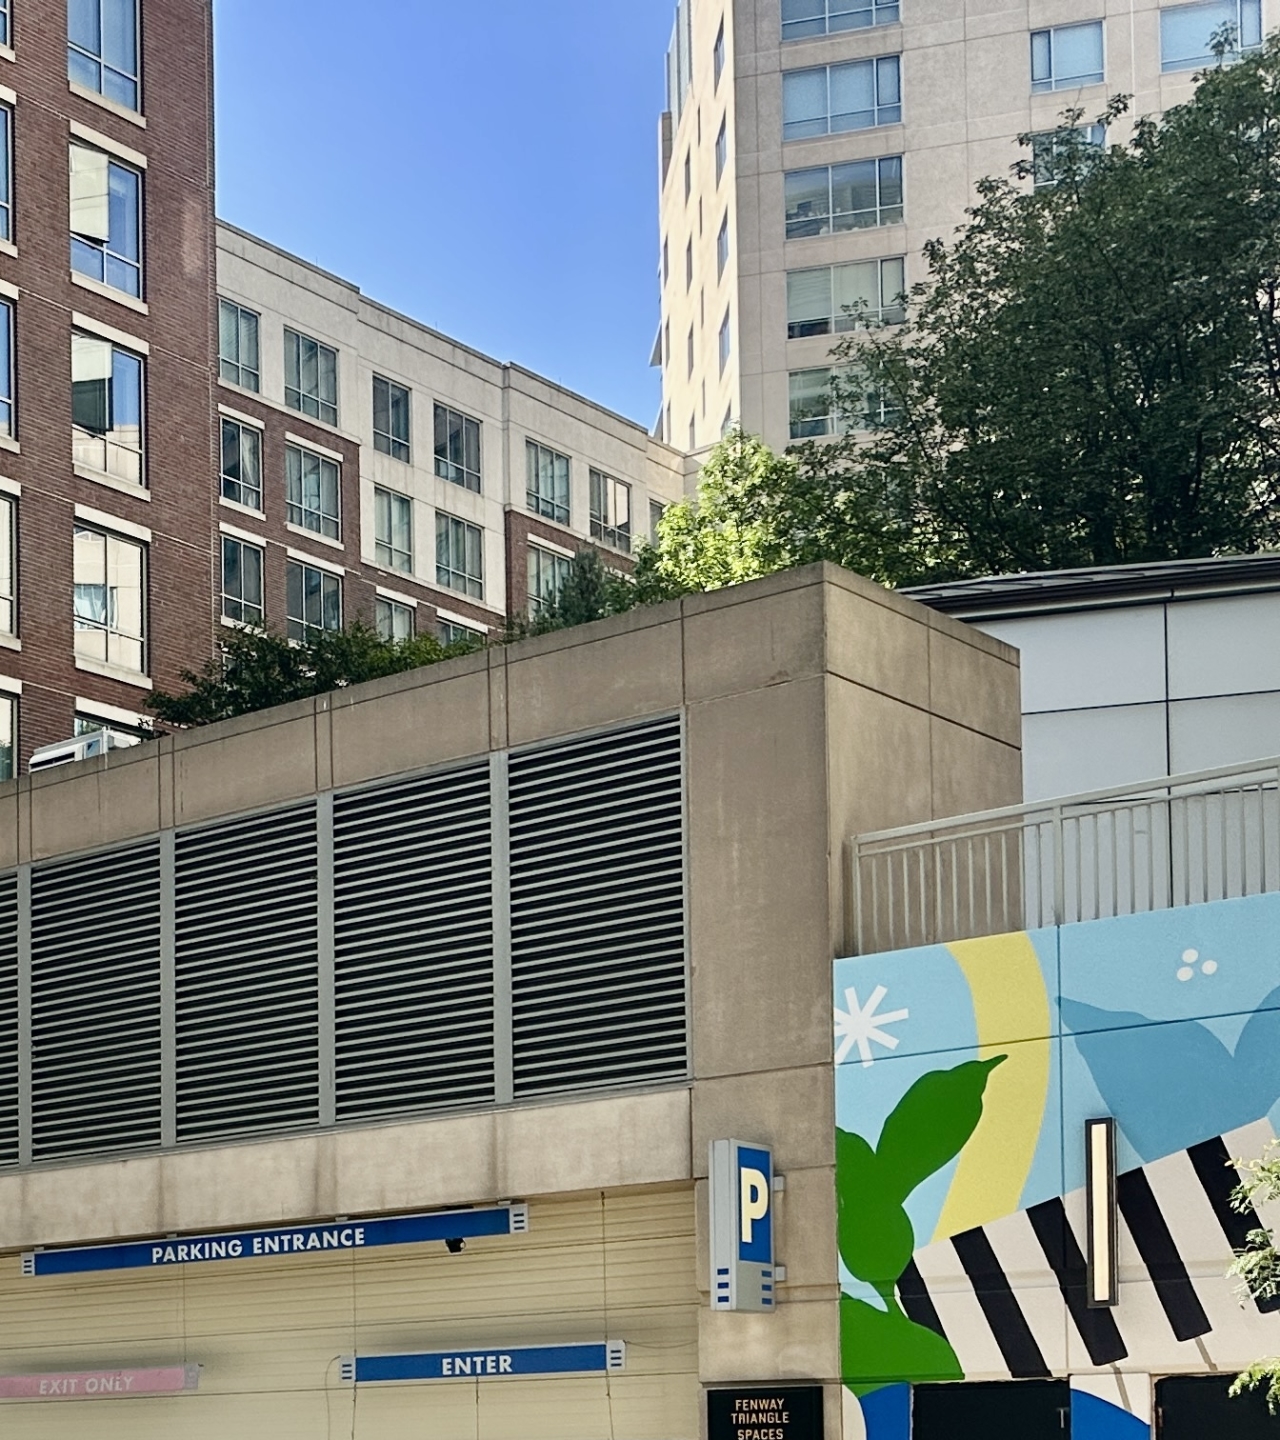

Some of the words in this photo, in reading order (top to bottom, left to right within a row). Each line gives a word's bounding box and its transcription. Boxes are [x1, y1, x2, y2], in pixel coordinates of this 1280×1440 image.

[740, 1166, 769, 1243] P
[152, 1240, 243, 1263] PARKING
[252, 1228, 365, 1254] ENTRANCE
[442, 1355, 513, 1375] ENTER
[39, 1378, 78, 1395] EXIT
[85, 1376, 133, 1393] ONLY
[735, 1398, 784, 1411] FENWAY
[731, 1412, 789, 1424] TRIANGLE
[737, 1428, 783, 1440] SPACES
